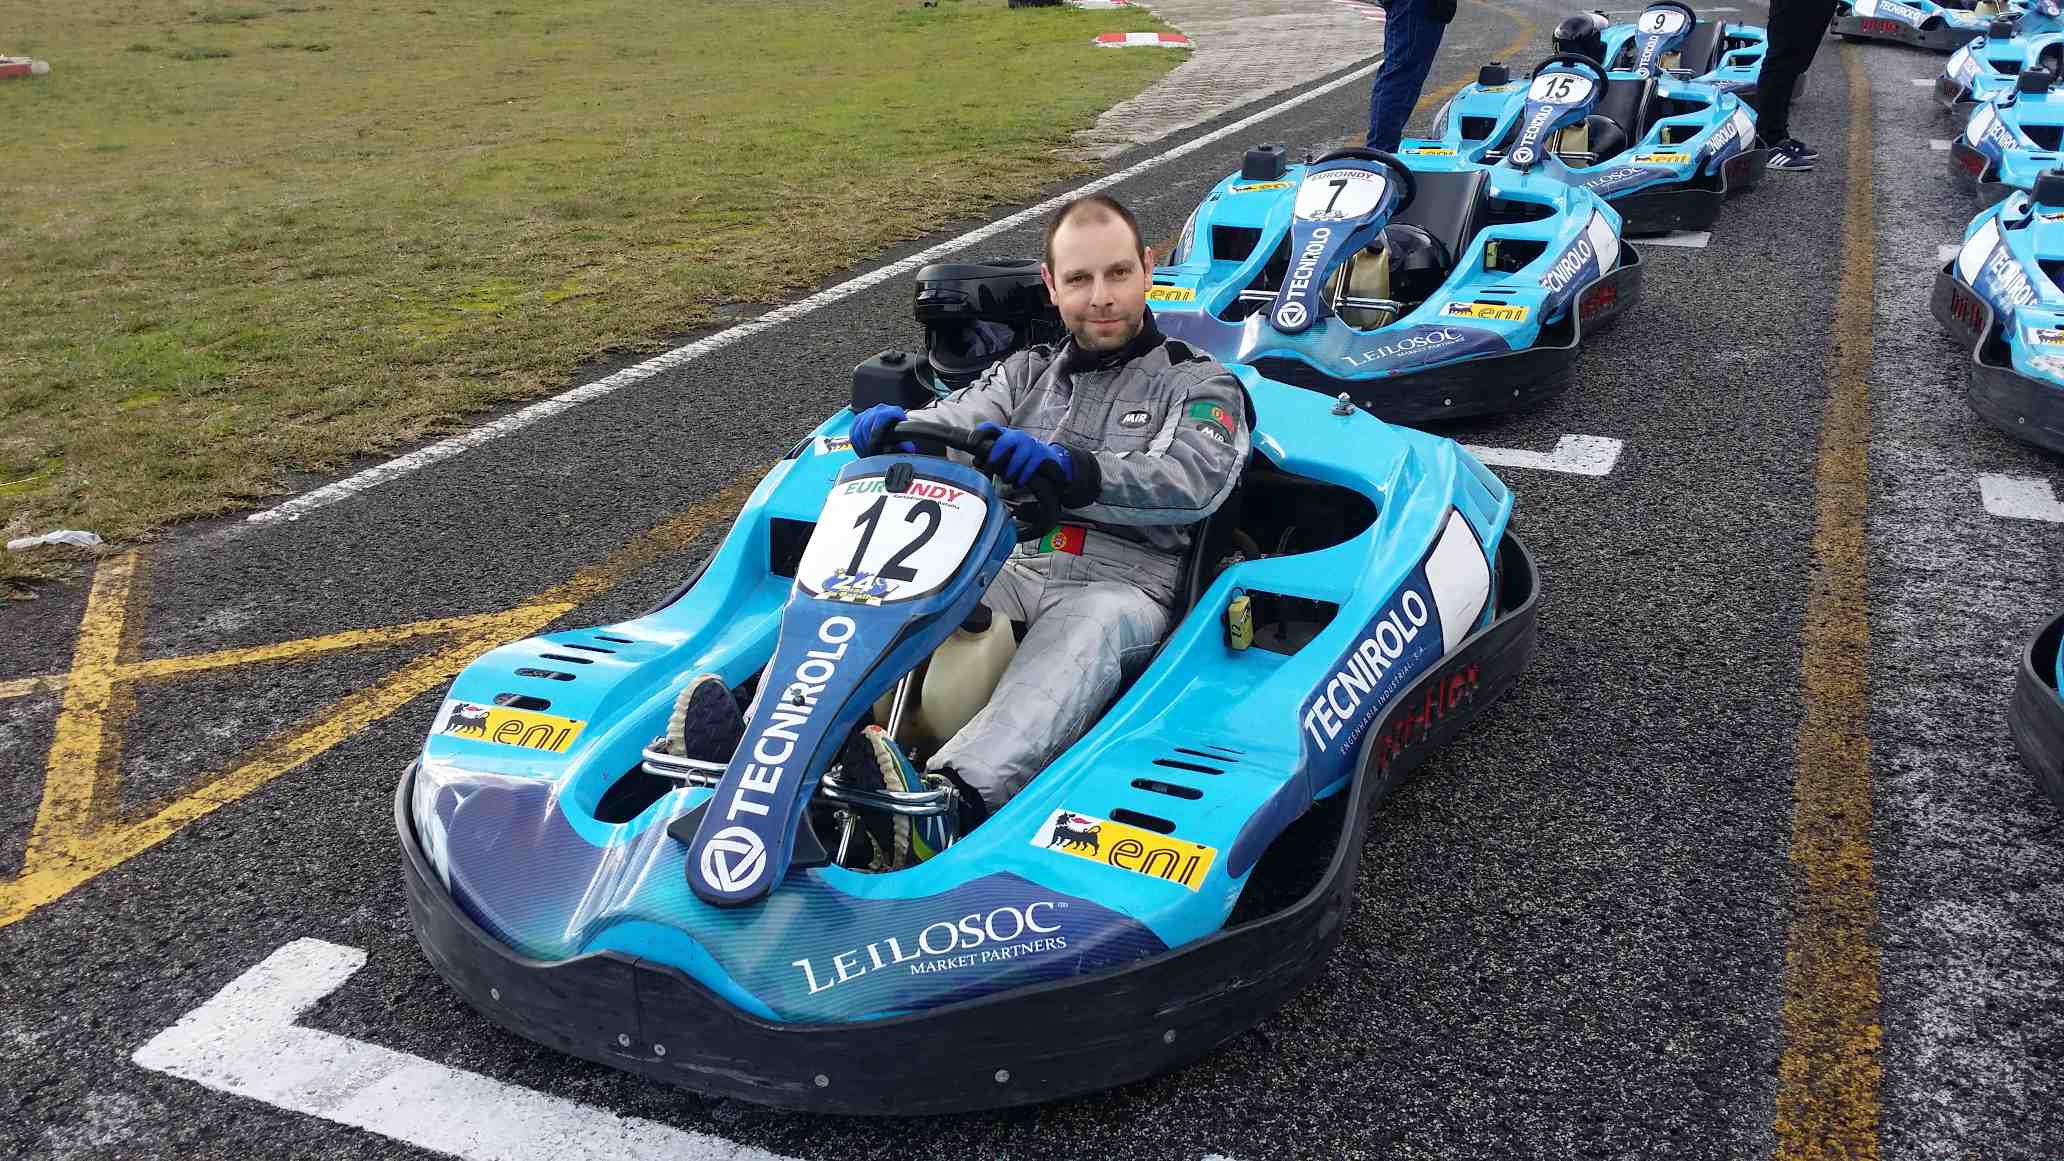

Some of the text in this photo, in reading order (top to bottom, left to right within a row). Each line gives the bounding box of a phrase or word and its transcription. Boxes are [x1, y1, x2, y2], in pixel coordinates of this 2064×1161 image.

[1654, 13, 1666, 30] 9
[1546, 77, 1574, 98] 15
[1328, 179, 1348, 214] 7
[1286, 227, 1331, 301] TECNIROLO
[1341, 327, 1462, 367] LEILOSOC
[1121, 413, 1148, 424] MIR
[852, 495, 942, 583] 12
[1304, 589, 1429, 752] TECNIROLO
[493, 719, 577, 751] eni
[726, 615, 857, 821] TECNIROLO
[1109, 839, 1207, 885] eni
[792, 902, 1062, 996] LEILOSOC
[910, 936, 1067, 976] MARKET PARTNERS
